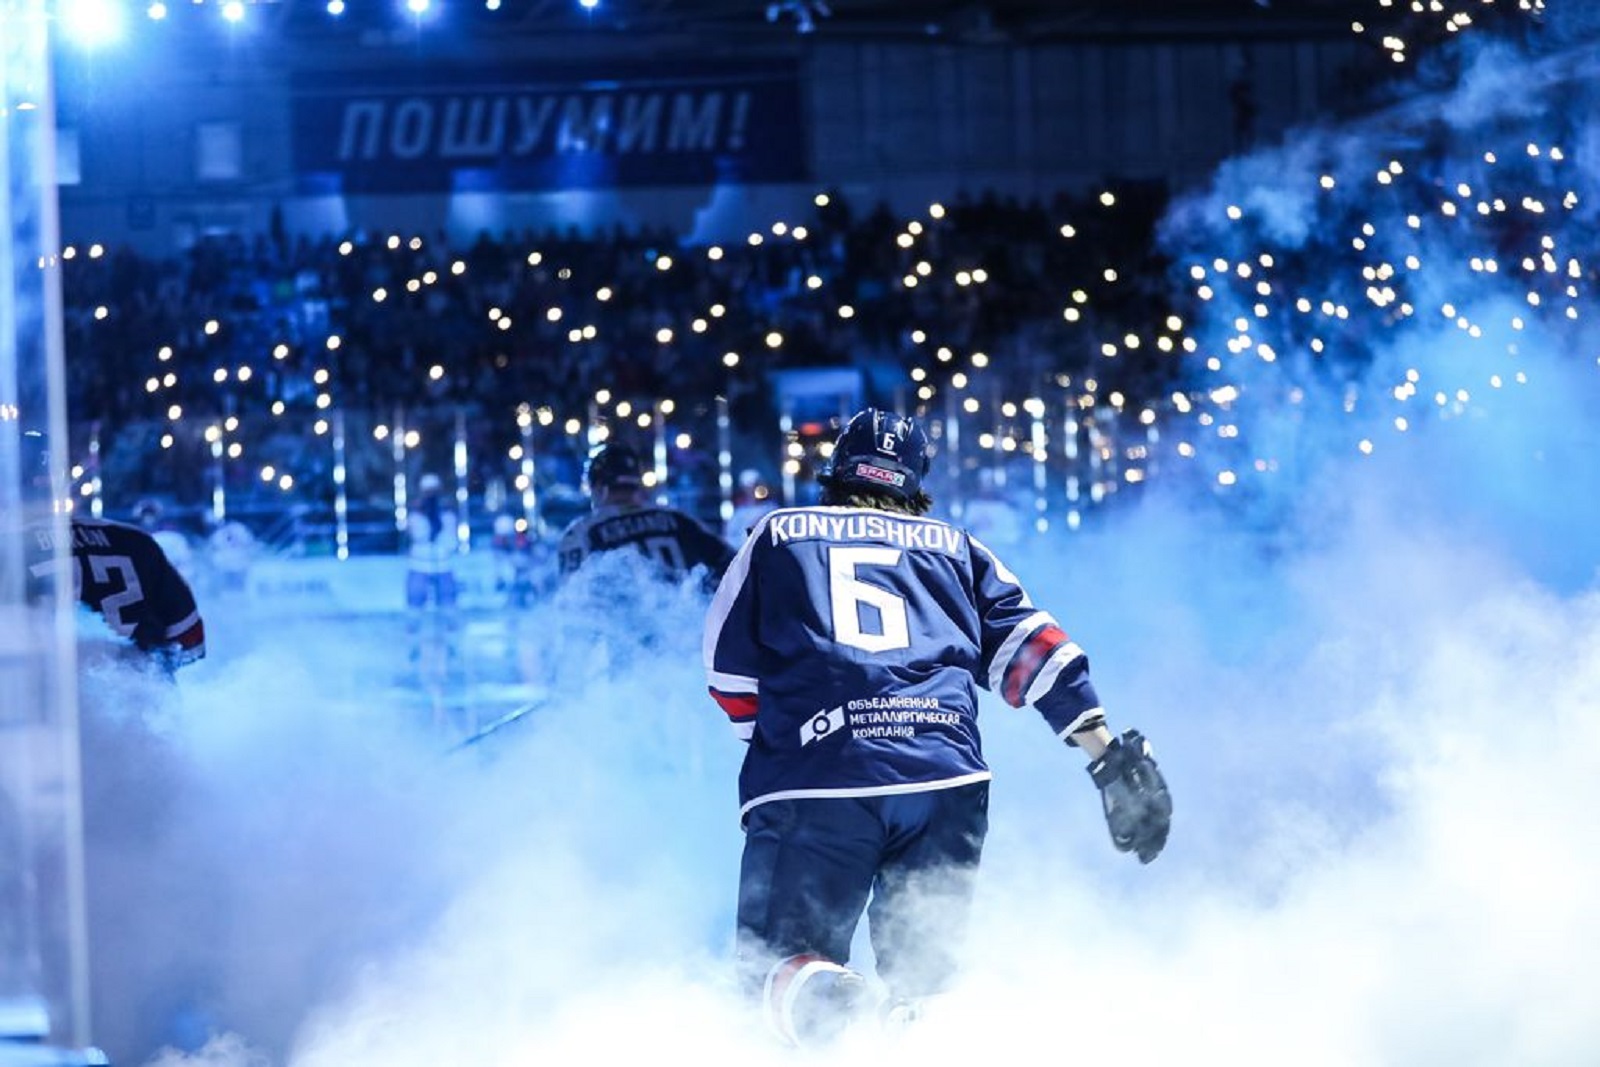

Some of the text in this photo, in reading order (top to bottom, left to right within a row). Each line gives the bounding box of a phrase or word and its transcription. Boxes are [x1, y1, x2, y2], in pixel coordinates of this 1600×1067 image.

[340, 93, 750, 159] ПОШУМИМ!
[883, 432, 896, 451] 6
[770, 513, 961, 554] KONYUSHKOV
[829, 547, 910, 653] 6
[850, 711, 960, 726] МЕТАЛЛУРГИЧЕСКАЯ
[852, 726, 915, 739] КОМПАНИЯ
